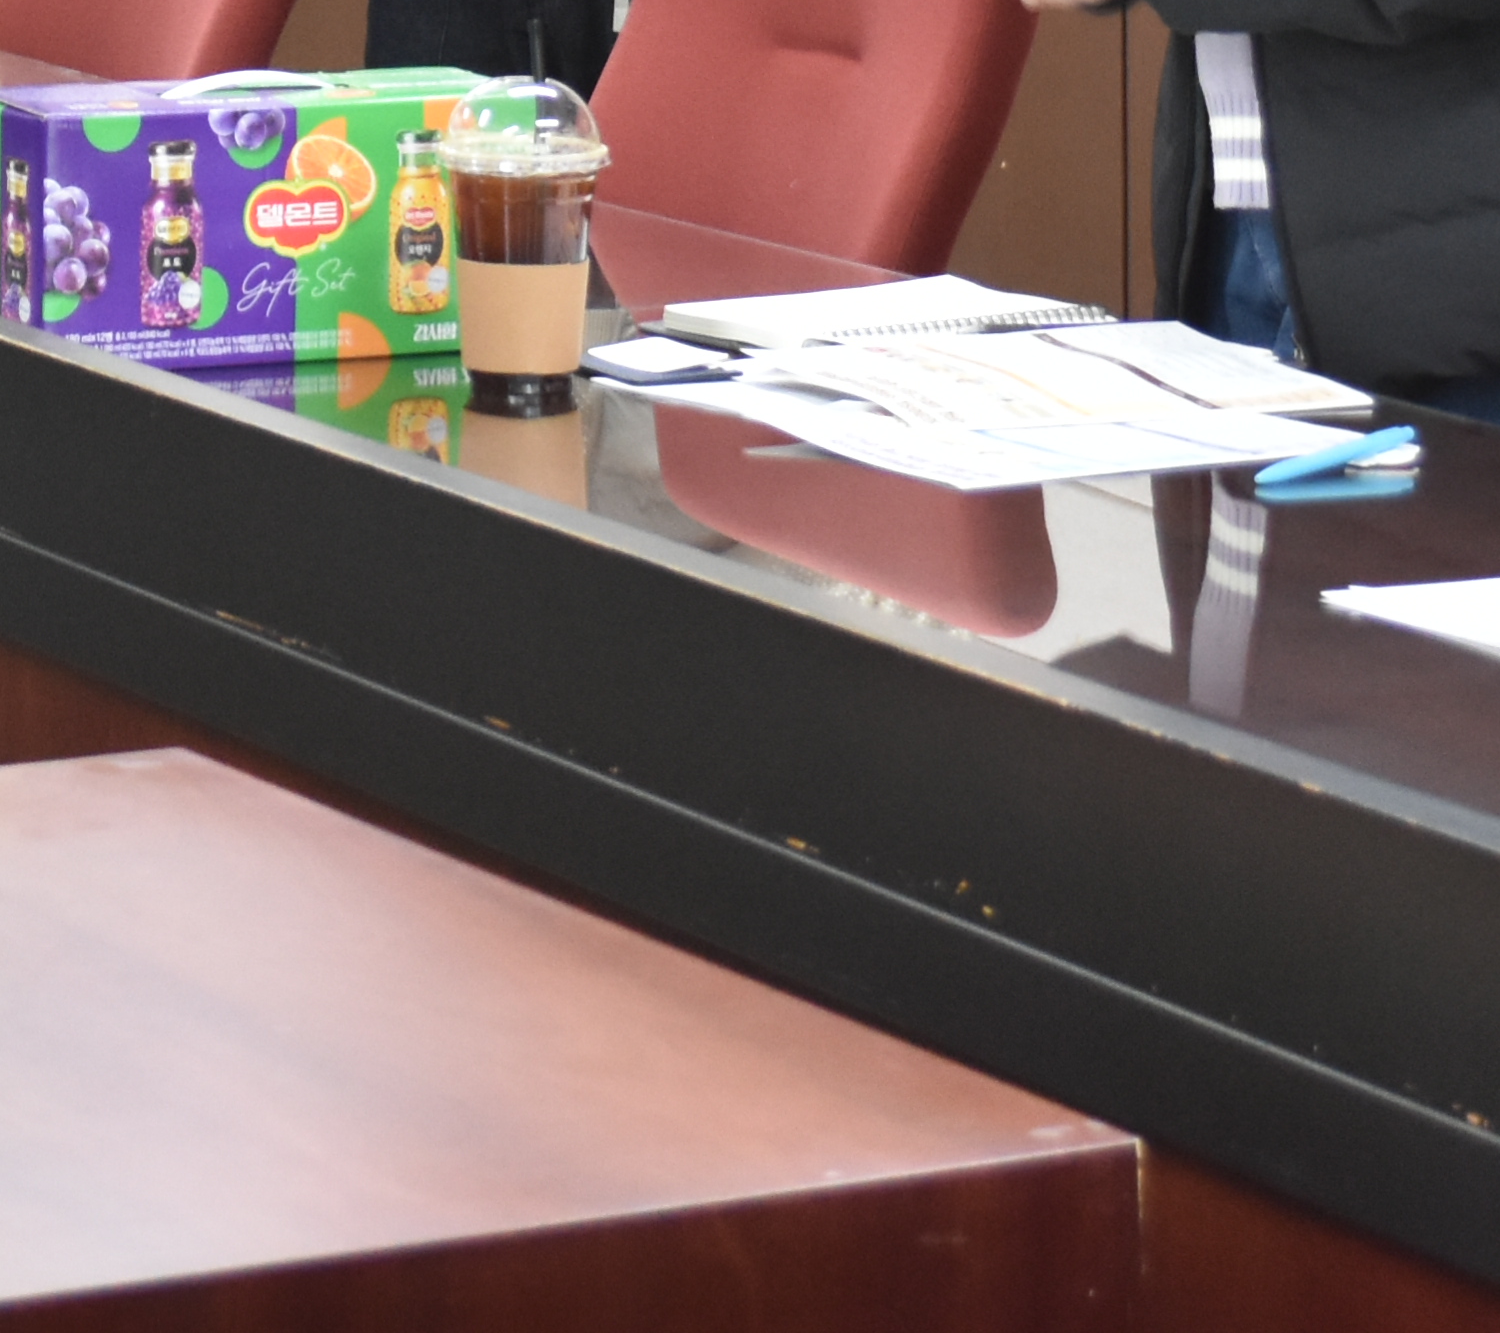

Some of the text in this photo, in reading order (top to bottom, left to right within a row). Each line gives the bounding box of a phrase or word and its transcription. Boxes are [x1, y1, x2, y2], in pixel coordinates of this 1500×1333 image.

[257, 201, 338, 228] 델몬트
[236, 257, 356, 317] Gift Set
